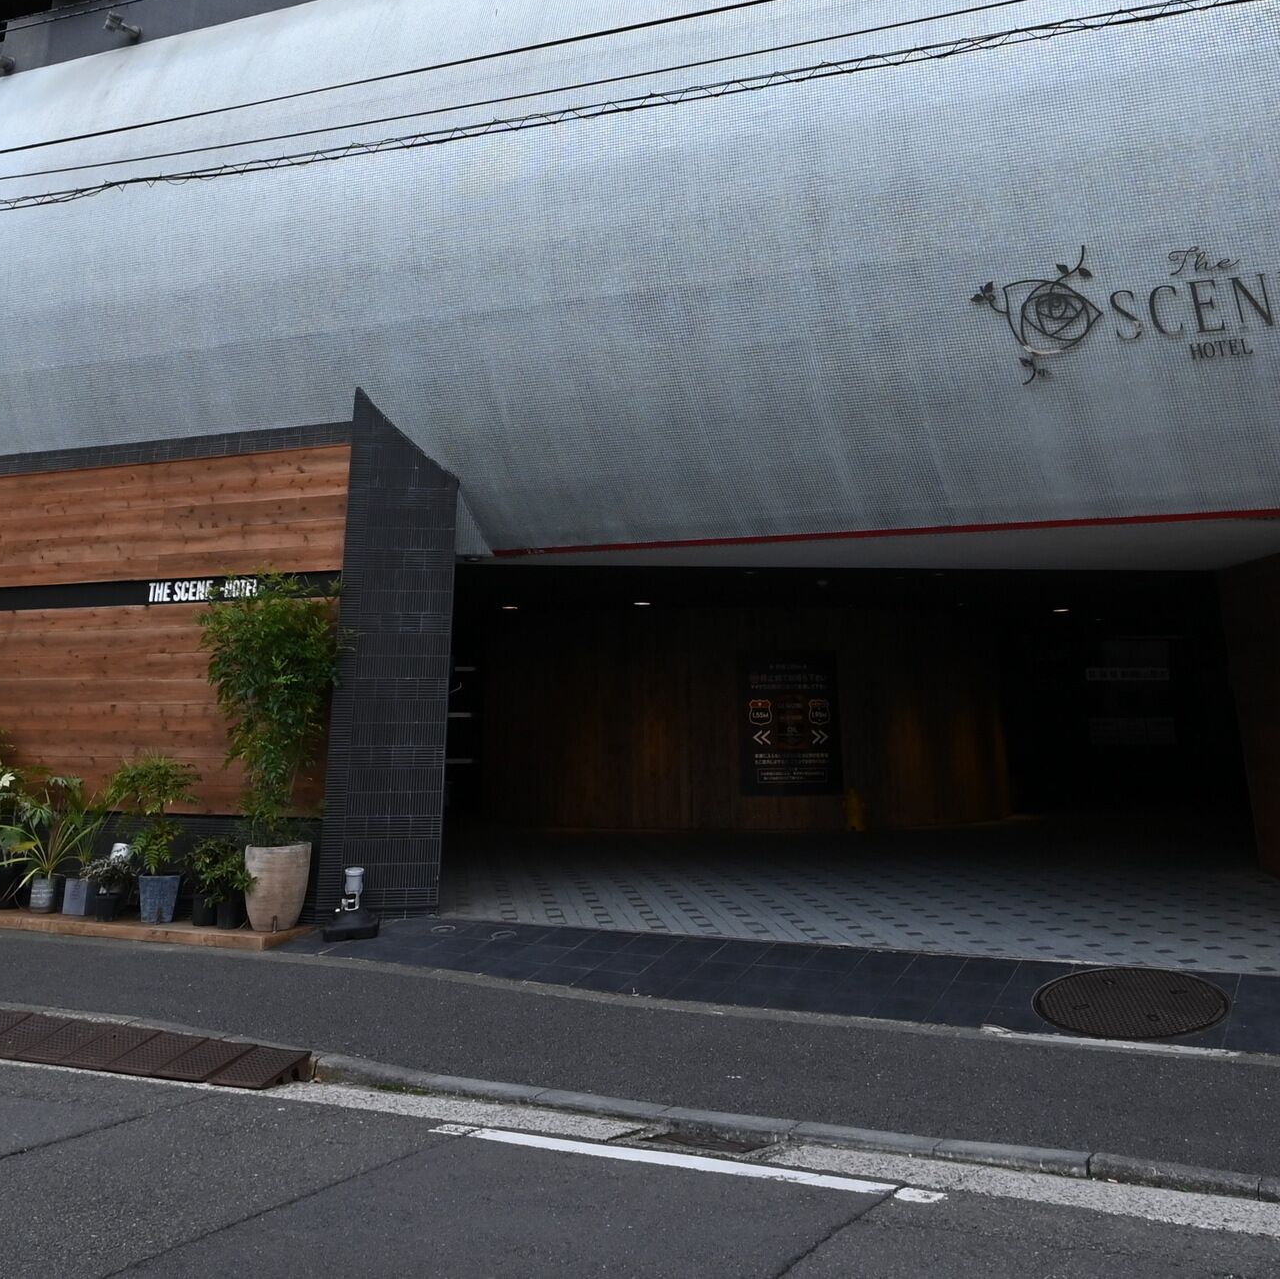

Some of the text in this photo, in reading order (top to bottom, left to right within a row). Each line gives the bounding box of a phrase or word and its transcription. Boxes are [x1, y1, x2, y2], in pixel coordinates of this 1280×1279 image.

[1168, 246, 1241, 275] The
[1189, 338, 1254, 360] HOTEL
[149, 582, 171, 602] THE
[173, 580, 214, 602] SCENE
